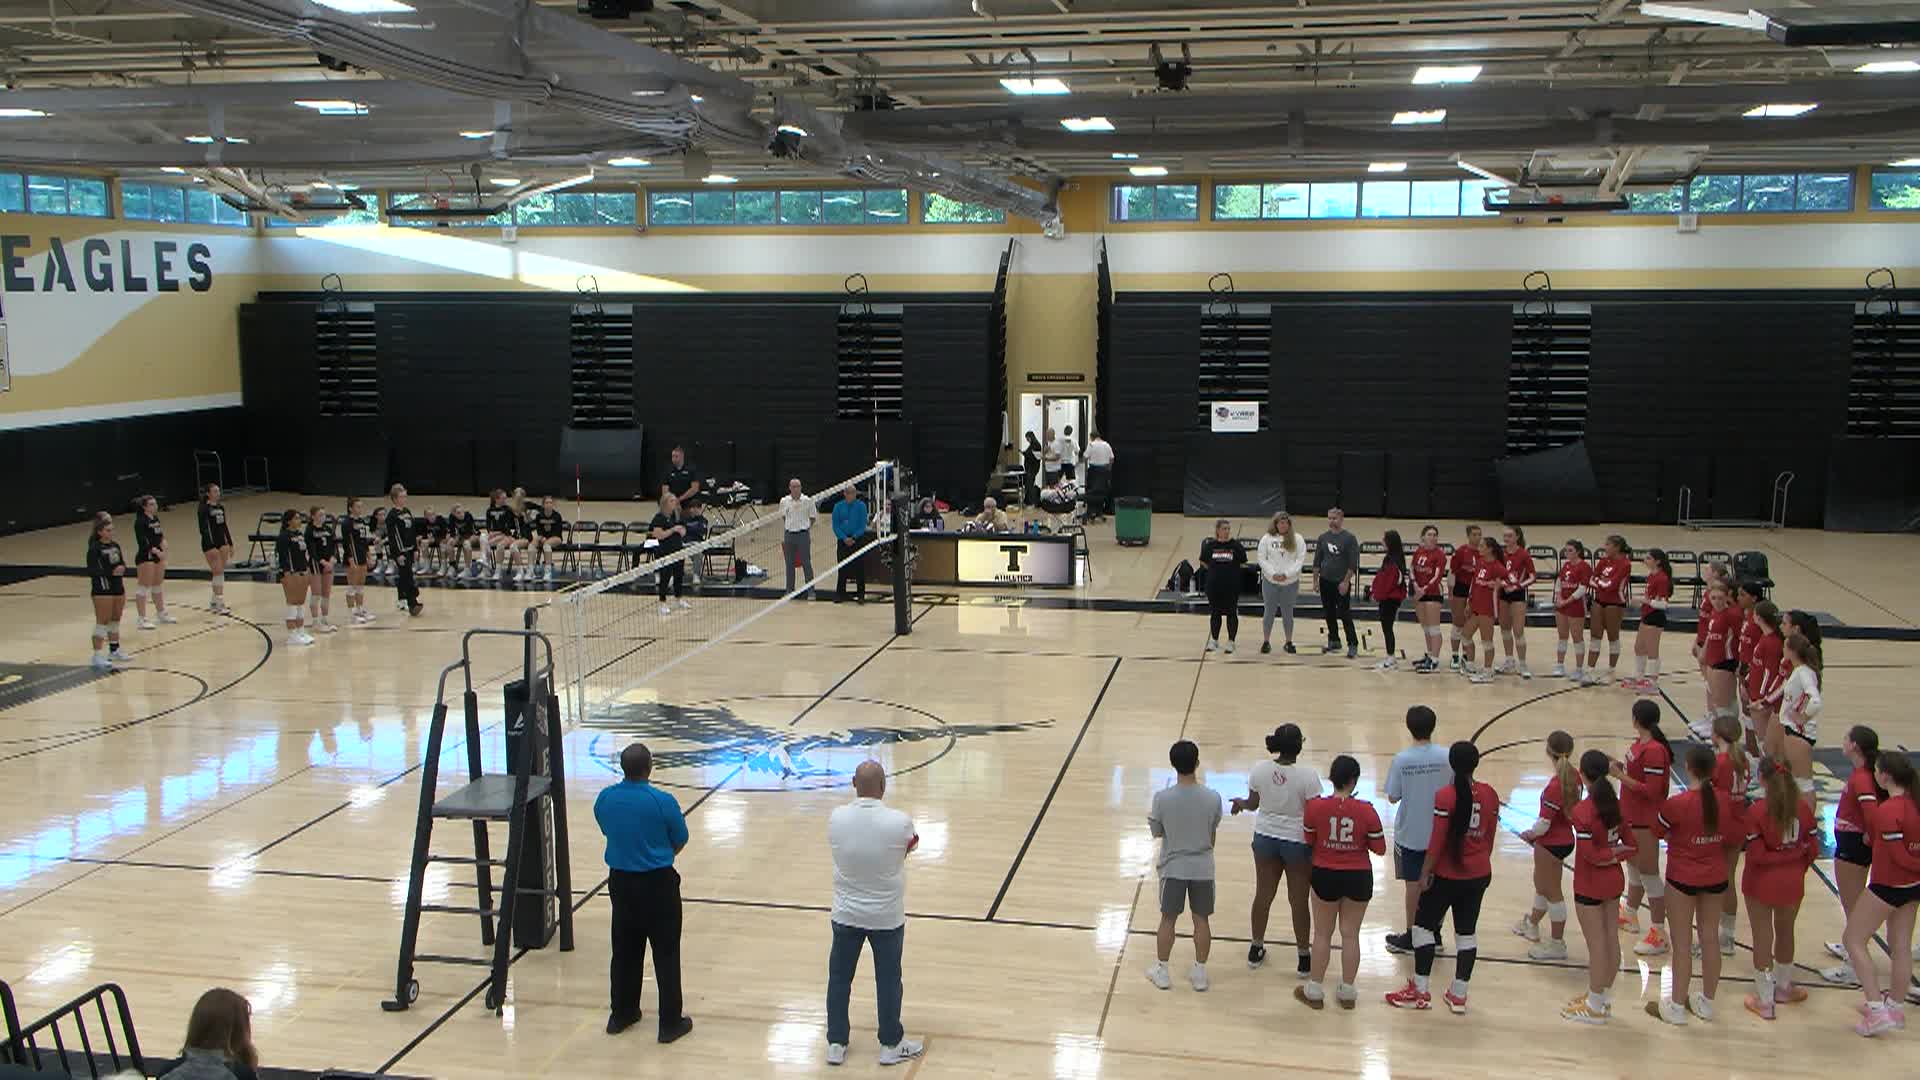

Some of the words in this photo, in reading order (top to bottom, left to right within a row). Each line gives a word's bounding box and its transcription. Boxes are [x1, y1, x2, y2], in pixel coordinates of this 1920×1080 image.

[1, 235, 212, 292] EAGLES
[1000, 545, 1028, 572] T
[994, 574, 1033, 582] ATHLETICS
[1328, 816, 1355, 843] 12
